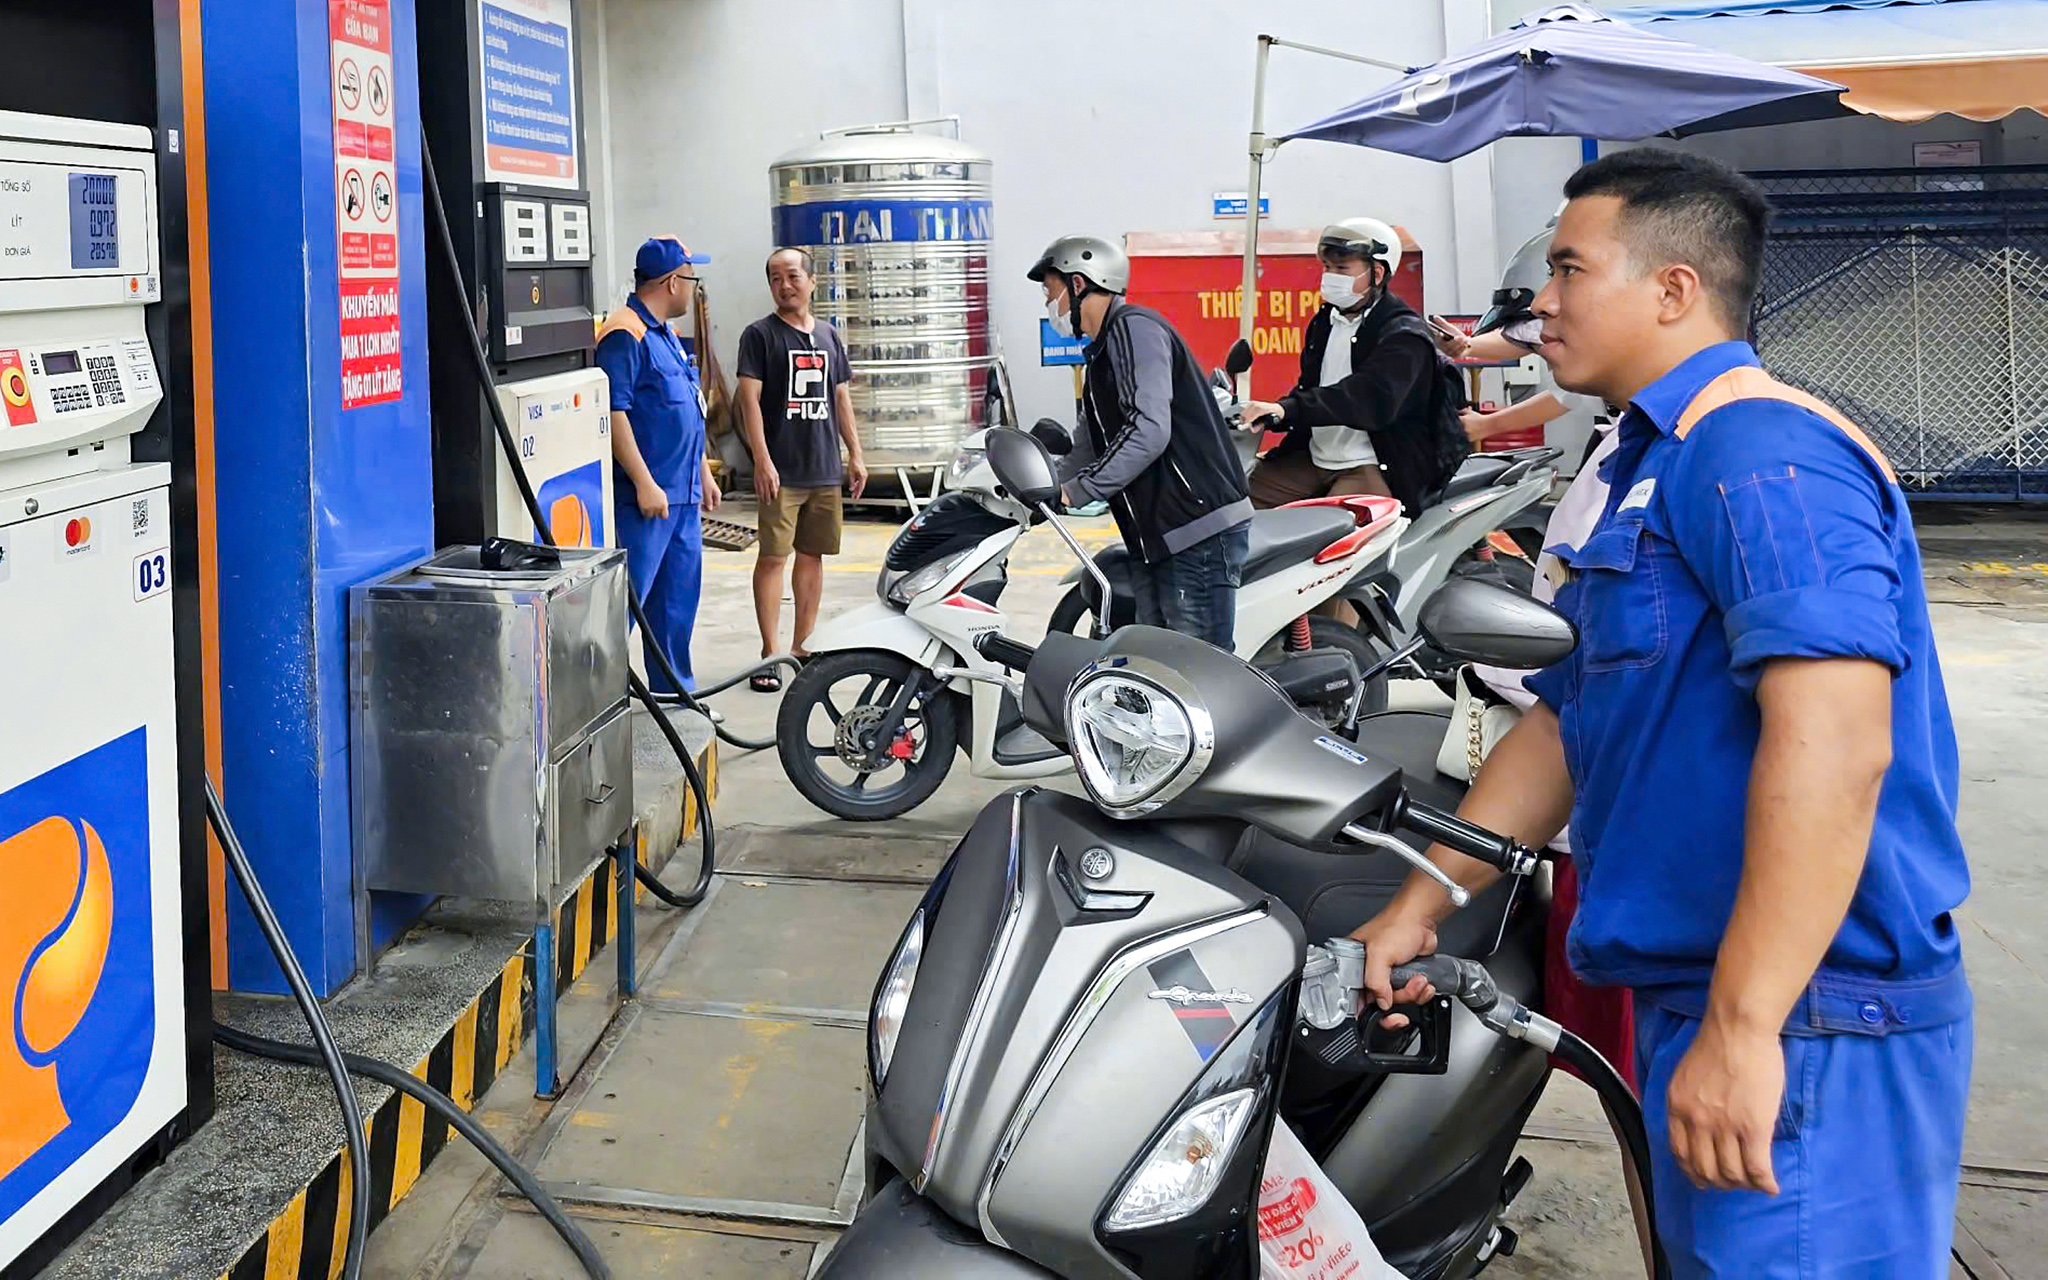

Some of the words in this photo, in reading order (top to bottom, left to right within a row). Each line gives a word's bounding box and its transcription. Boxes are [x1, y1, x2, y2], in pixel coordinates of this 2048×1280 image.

[345, 14, 361, 38] CỦA
[362, 22, 379, 44] BẠN
[83, 176, 115, 205] 20000
[11, 214, 23, 227] LÍT
[342, 286, 380, 319] KHUYẾN
[381, 287, 398, 316] MÃI
[1269, 290, 1292, 323] BỊ
[342, 335, 359, 360] MUA
[359, 334, 364, 358] 1
[364, 332, 380, 357] LON
[1253, 326, 1300, 354] OAM
[343, 370, 363, 407] TẶNG
[363, 372, 372, 398] 01
[372, 365, 382, 396] LÍT
[527, 403, 543, 420] VISA
[599, 415, 609, 434] 01
[786, 401, 828, 420] FILA
[522, 435, 535, 458] 02
[140, 555, 165, 593] 03
[967, 624, 1001, 632] HONDA
[1284, 1227, 1324, 1268] 20%
